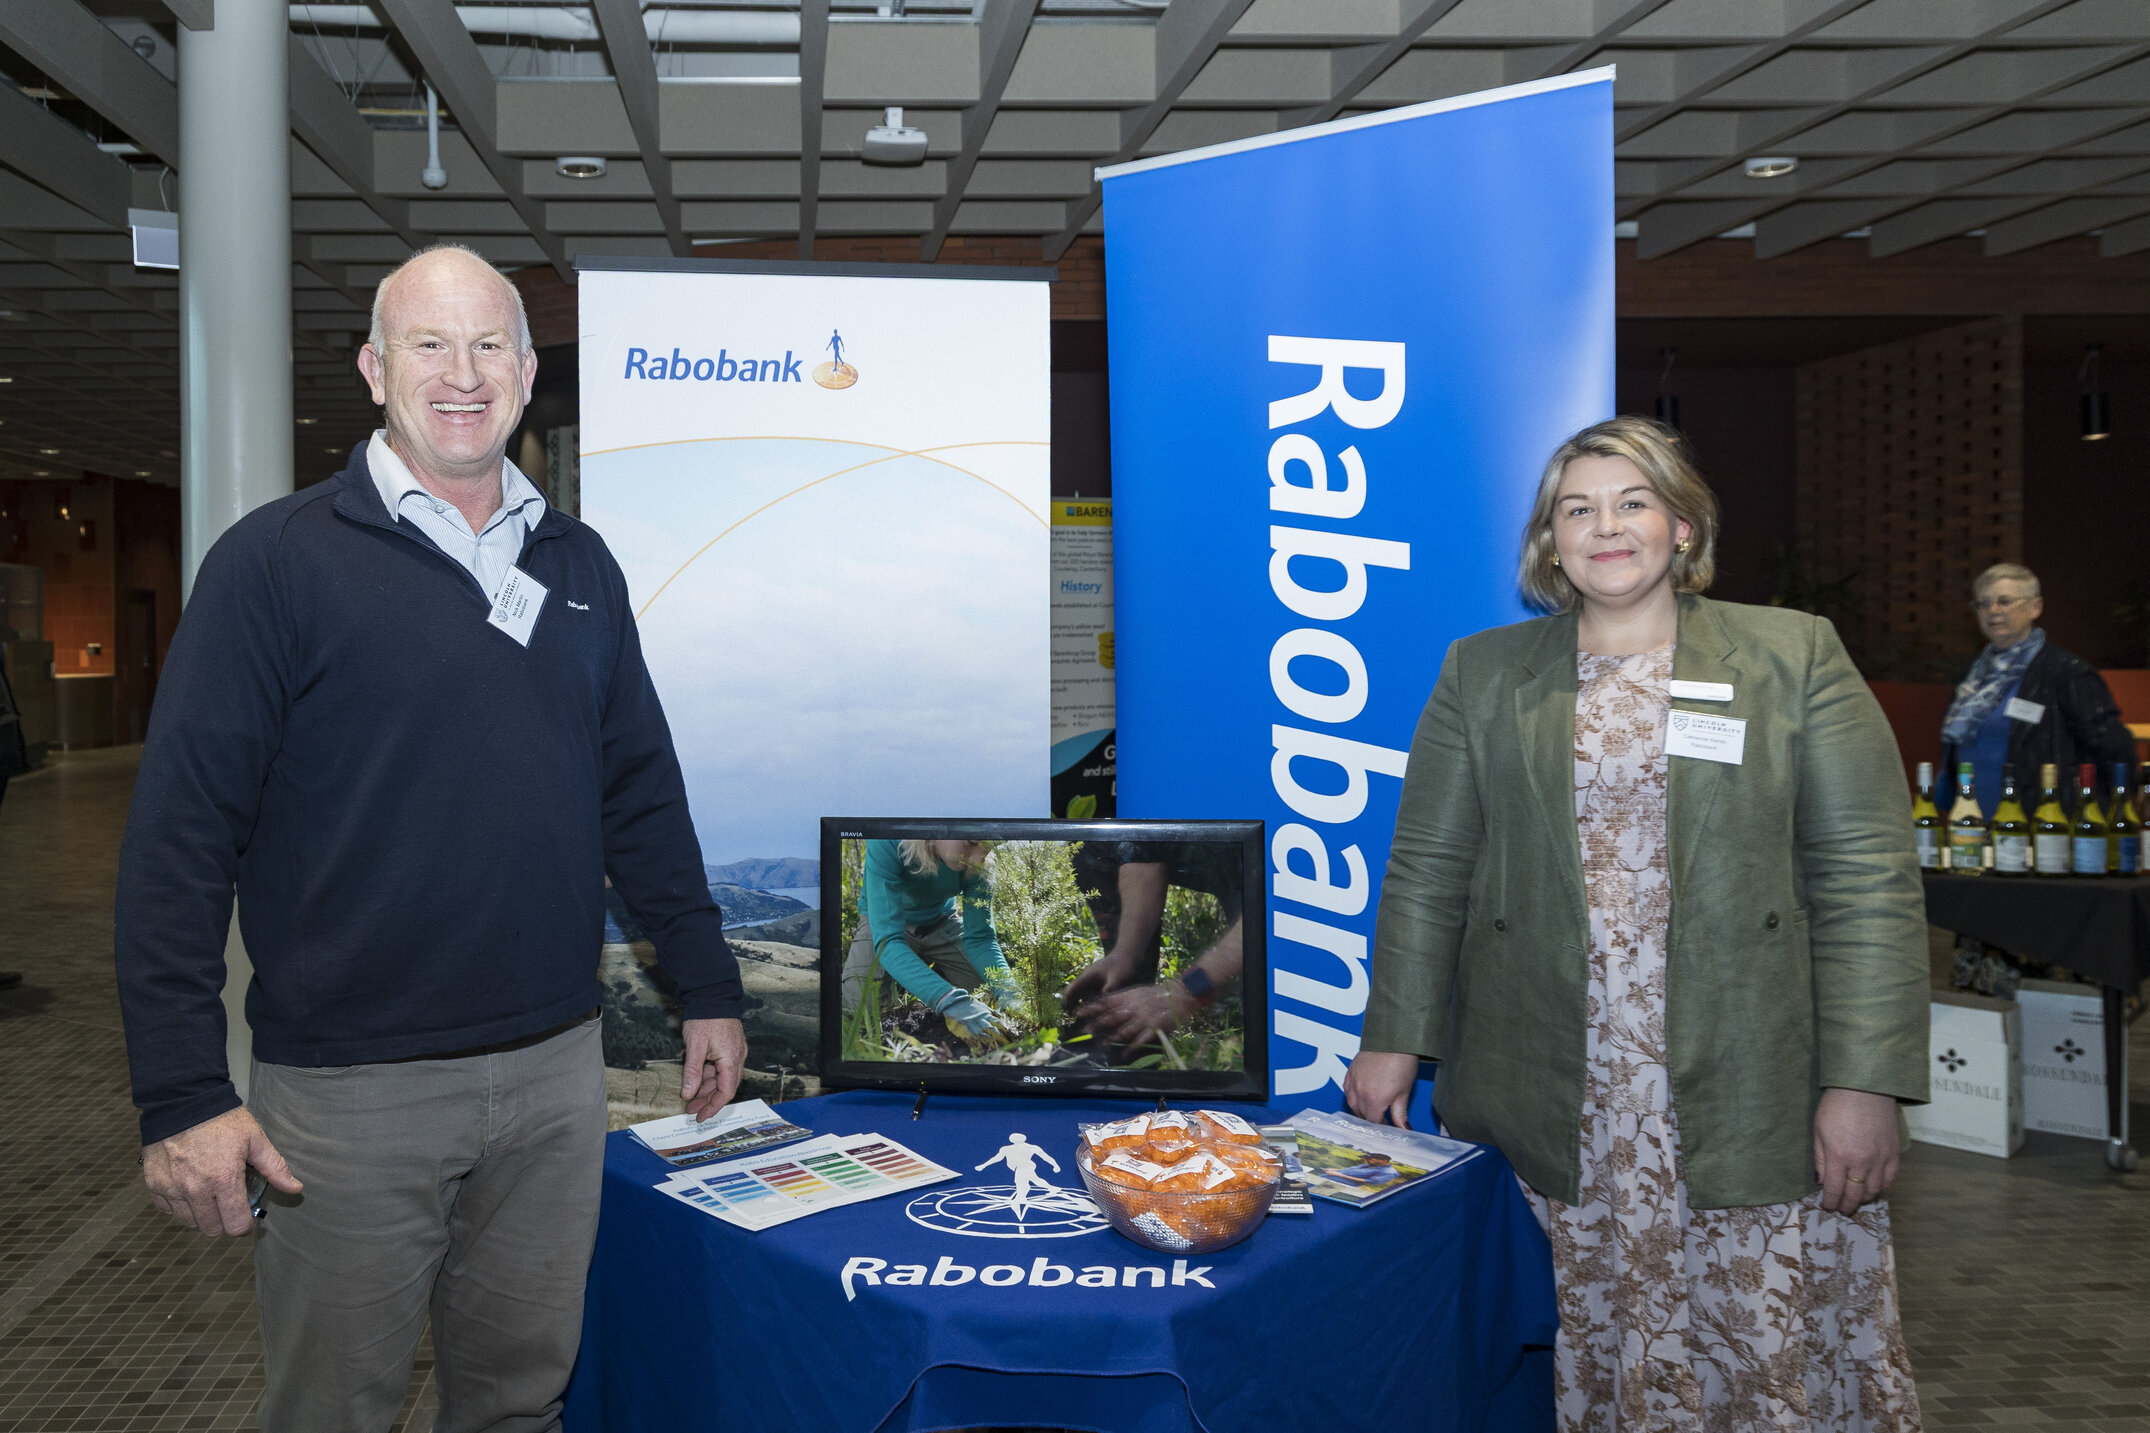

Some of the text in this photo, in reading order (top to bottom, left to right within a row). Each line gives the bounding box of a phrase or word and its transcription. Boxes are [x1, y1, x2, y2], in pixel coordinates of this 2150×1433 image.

[624, 347, 803, 383] Rabobank
[500, 583, 511, 606] LINCOLN
[503, 576, 519, 609] UNIVERSITY
[1061, 580, 1103, 594] History
[1267, 334, 1411, 1096] Rabobank
[1692, 718, 1727, 727] LINCOLN
[1692, 724, 1741, 734] UNIVERSITY
[1083, 765, 1102, 777] and
[1023, 1075, 1056, 1084] SONY
[1335, 1119, 1413, 1143] Rabobank
[761, 1153, 797, 1165] Education
[797, 1145, 833, 1158] Roadmap
[841, 1256, 1217, 1302] Rabobank
